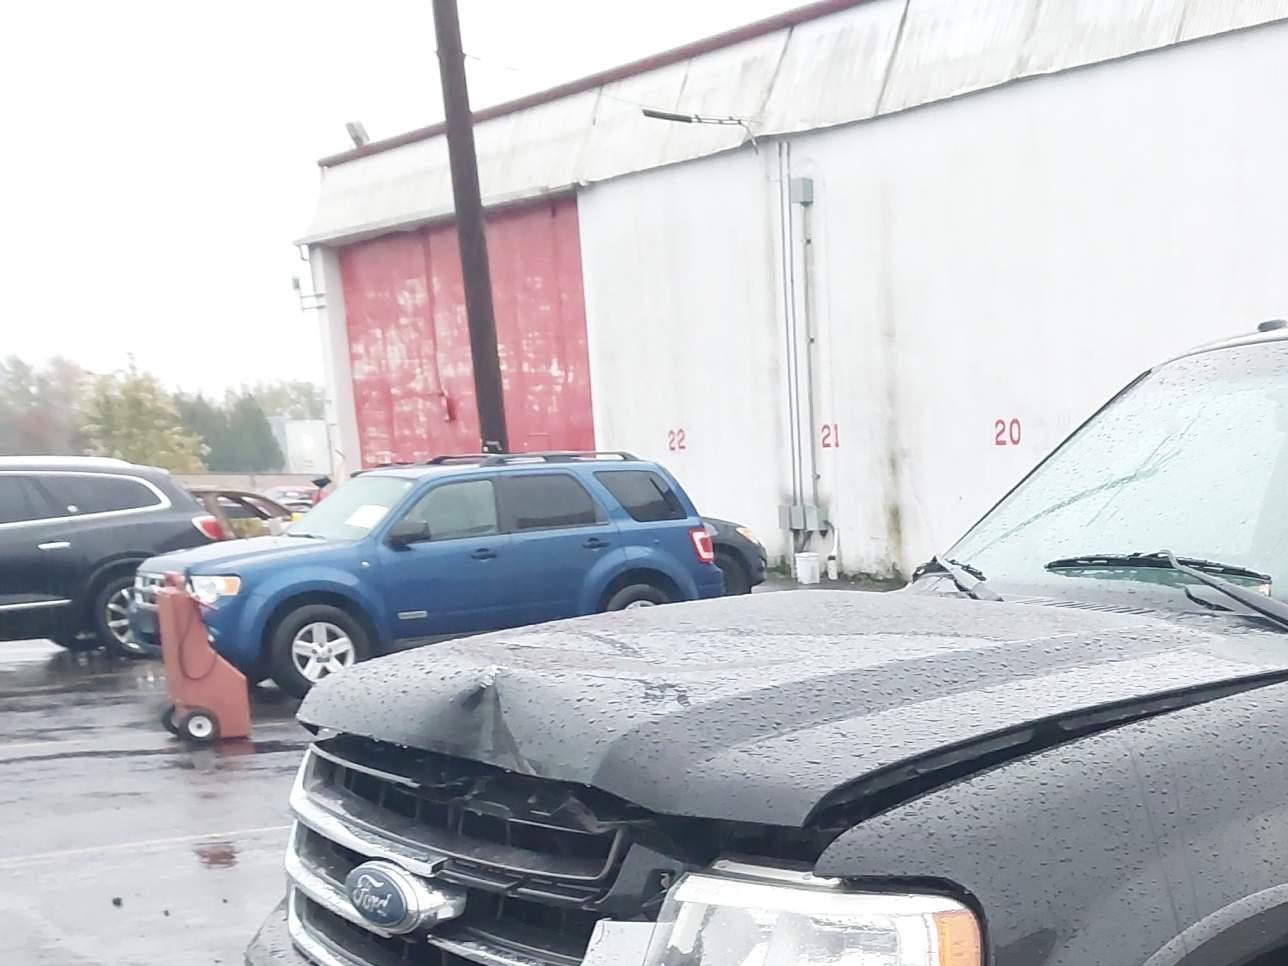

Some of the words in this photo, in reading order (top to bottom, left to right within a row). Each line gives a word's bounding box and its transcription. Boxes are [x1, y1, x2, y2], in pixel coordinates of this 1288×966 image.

[668, 428, 686, 452] 22
[821, 424, 840, 448] 21
[994, 418, 1021, 447] 20
[352, 874, 393, 917] Ford
